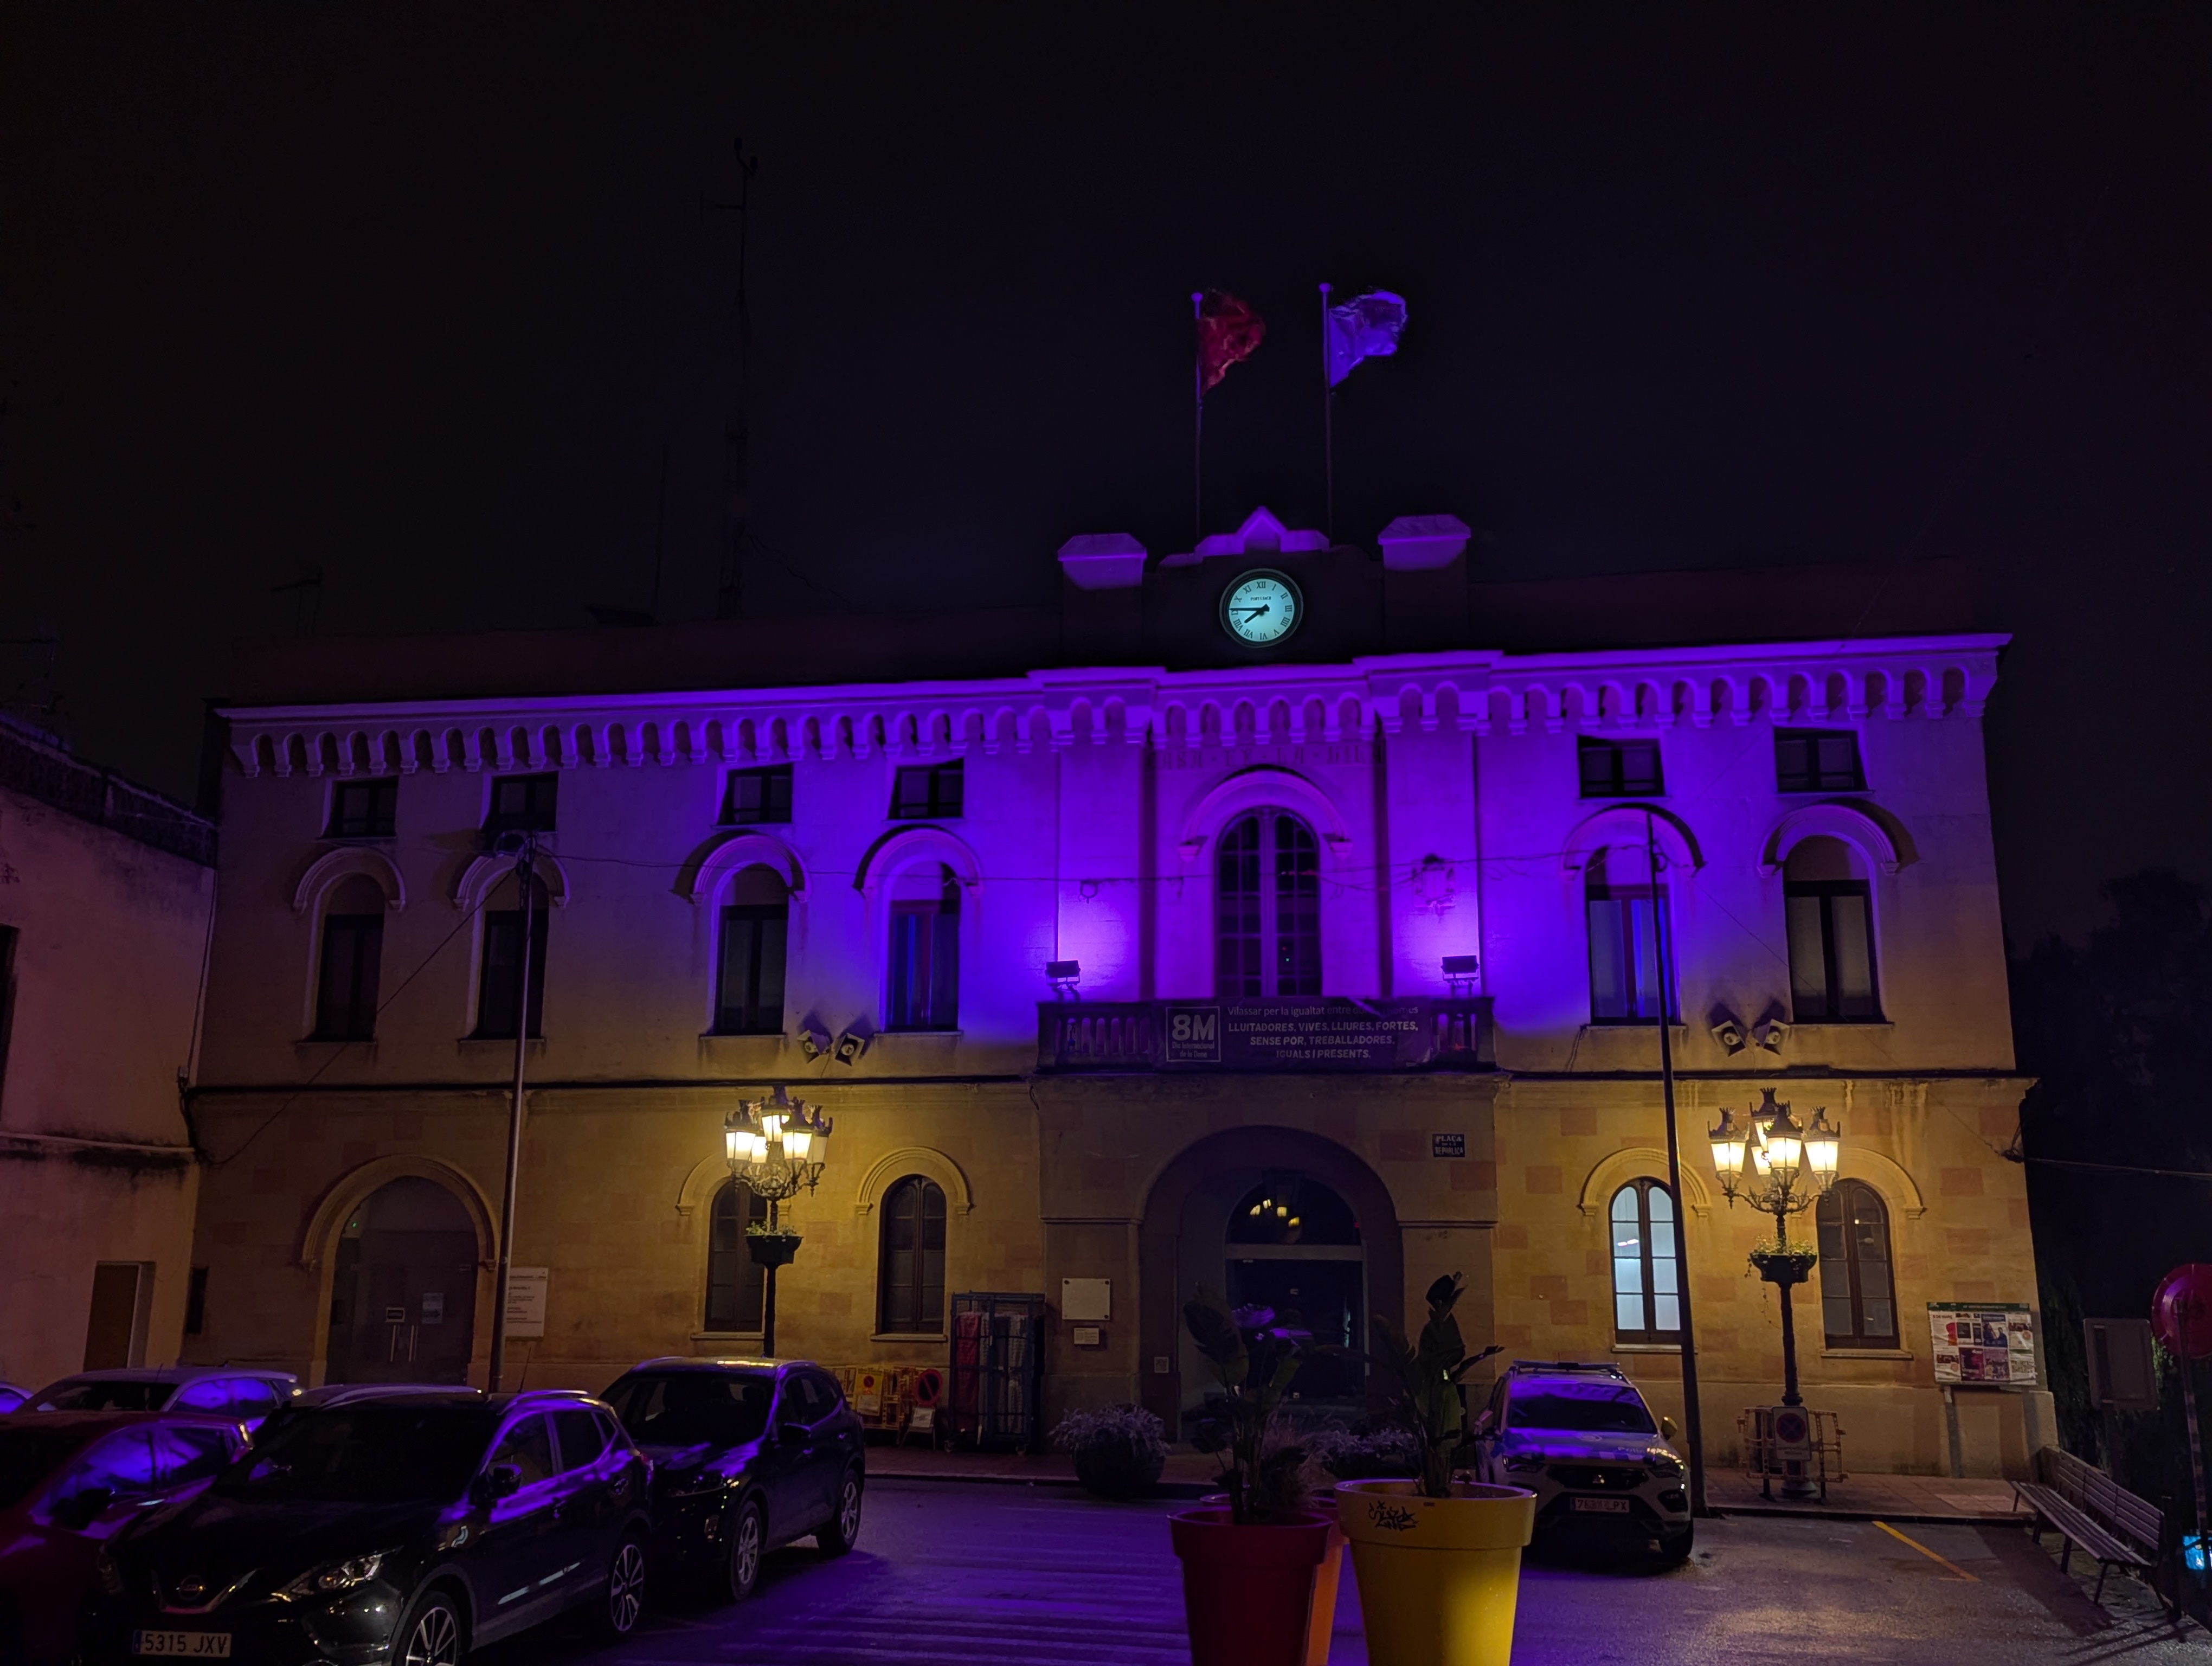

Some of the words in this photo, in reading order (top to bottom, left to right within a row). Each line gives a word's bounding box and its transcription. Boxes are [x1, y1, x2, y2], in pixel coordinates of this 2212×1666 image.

[1243, 585, 1252, 594] XI
[1281, 592, 1288, 600] II
[1233, 618, 1243, 631] VIII
[1280, 617, 1290, 627] IIII
[1243, 629, 1253, 639] VII
[1227, 1006, 1262, 1015] Vilassar
[1264, 1008, 1279, 1017] per
[1281, 1006, 1289, 1015] la
[1291, 1005, 1325, 1017] igualtat
[1327, 1006, 1351, 1015] entre
[1172, 1014, 1215, 1041] 8M
[1228, 1022, 1297, 1031] LLUITADORES,
[1376, 1021, 1418, 1031] FORTES,
[1182, 1041, 1215, 1049] Internacional
[1250, 1036, 1281, 1046] SENSE
[1283, 1036, 1307, 1046] POR,
[1309, 1035, 1395, 1045] TREBALLADORES,
[1180, 1049, 1186, 1058] de
[1187, 1049, 1193, 1058] la
[1194, 1050, 1207, 1058] Dona
[1276, 1049, 1310, 1059] IGUALS
[1313, 1049, 1315, 1059] I
[145, 1633, 186, 1652] 5315
[194, 1636, 227, 1654] JXV
